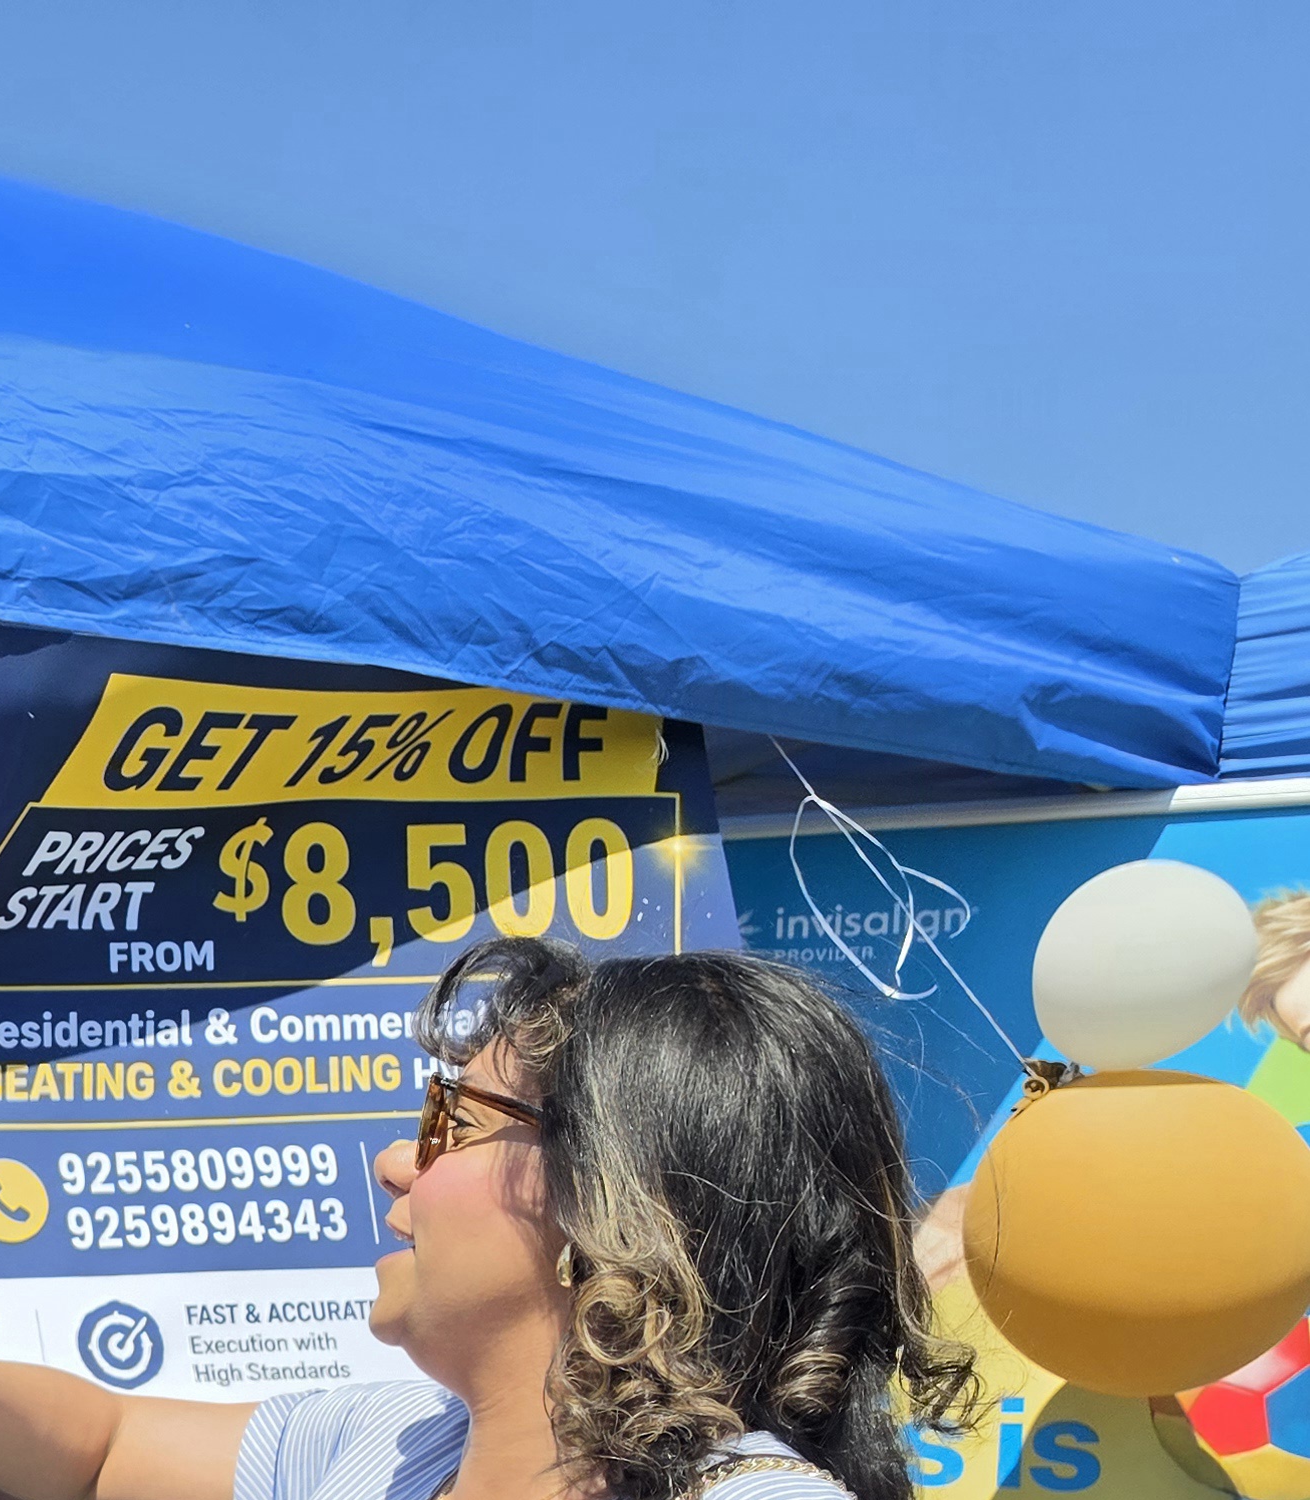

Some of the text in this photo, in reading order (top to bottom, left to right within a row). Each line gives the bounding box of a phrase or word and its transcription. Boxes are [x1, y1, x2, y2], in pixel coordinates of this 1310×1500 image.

[102, 700, 608, 791] GET 15% OFF
[23, 825, 205, 877] PRICES
[212, 816, 634, 967] $8,500
[108, 940, 215, 973] FROM
[205, 1007, 239, 1046] &
[167, 1060, 202, 1099] &
[213, 1054, 401, 1098] COOLING
[57, 1143, 339, 1196] 9255809999
[67, 1197, 348, 1250] 9259894343
[186, 1303, 238, 1325] FAST
[245, 1303, 261, 1324] &
[190, 1332, 338, 1355] Execution with
[193, 1361, 351, 1387] High Standards
[996, 1397, 1101, 1492] is
